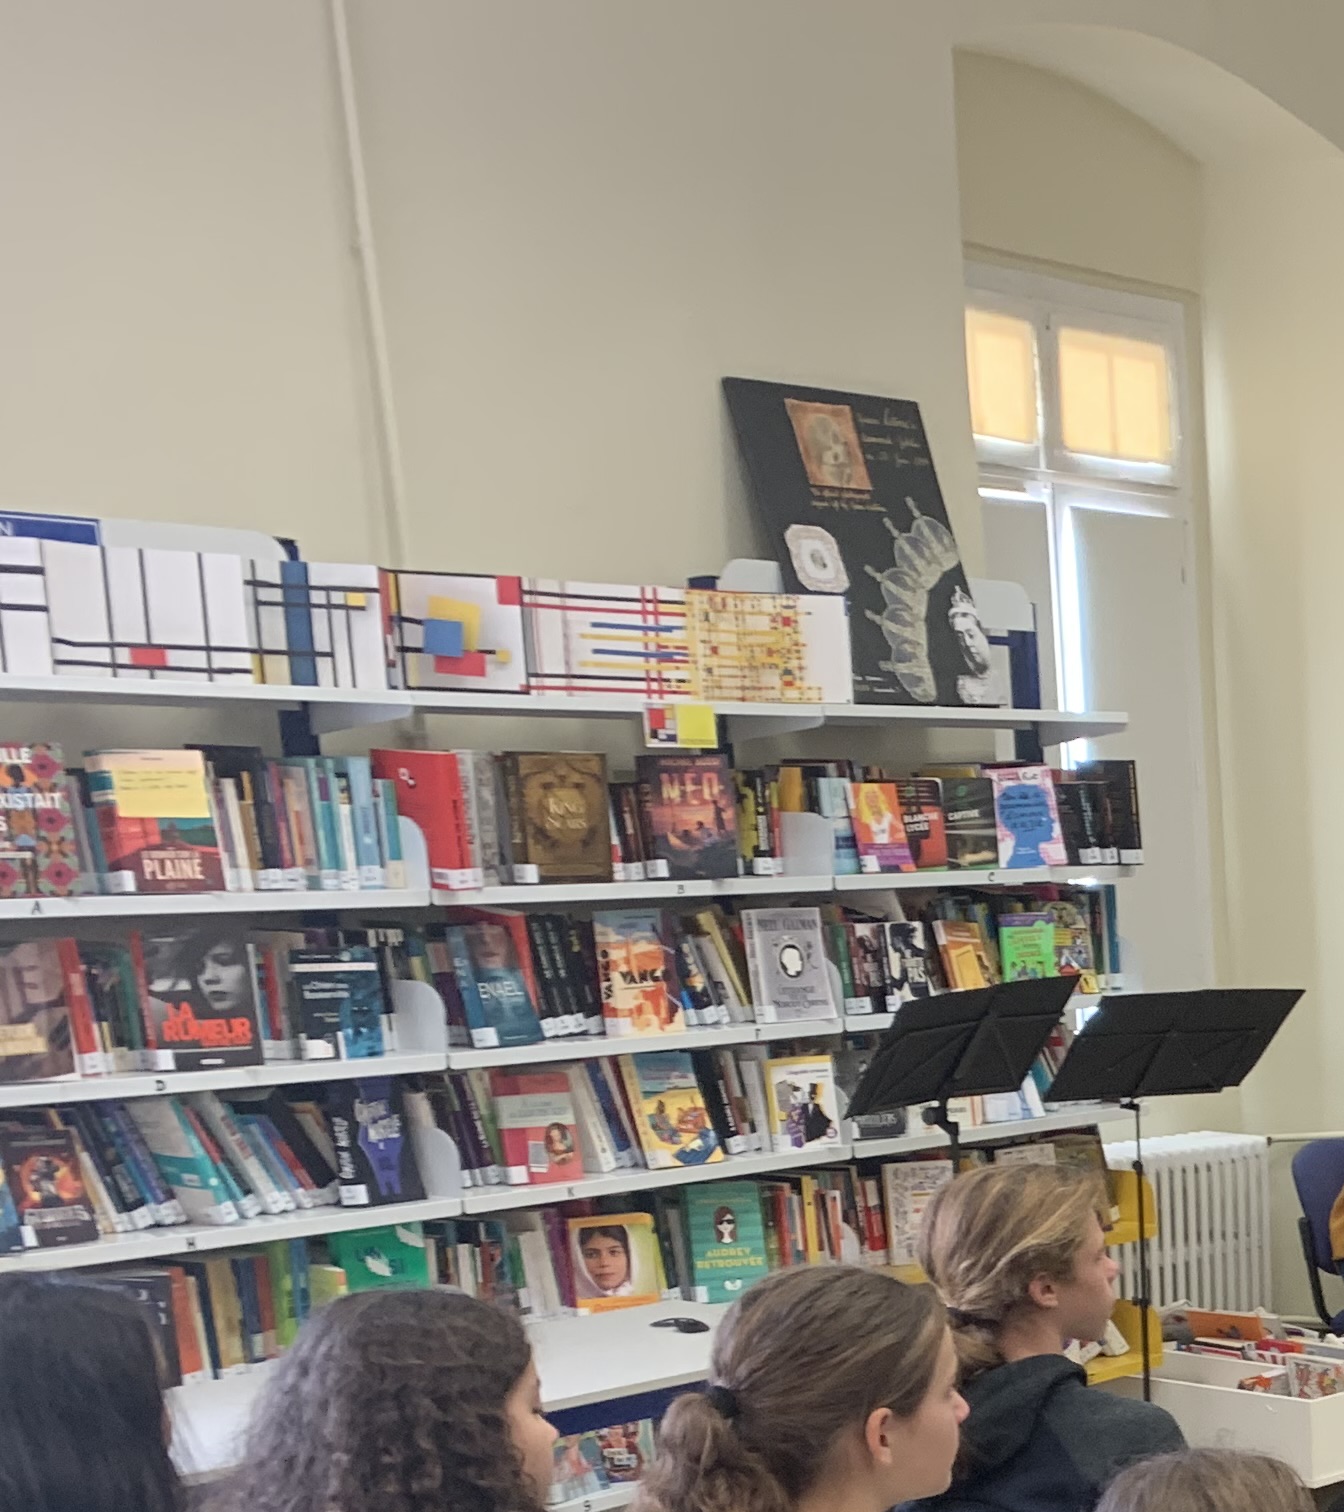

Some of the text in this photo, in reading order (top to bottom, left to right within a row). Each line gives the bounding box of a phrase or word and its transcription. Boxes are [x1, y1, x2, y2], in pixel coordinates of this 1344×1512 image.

[142, 858, 205, 880] PLAINE
[166, 1001, 195, 1019] LA
[162, 1017, 253, 1047] RUMEUR
[706, 1247, 752, 1258] AUDREY
